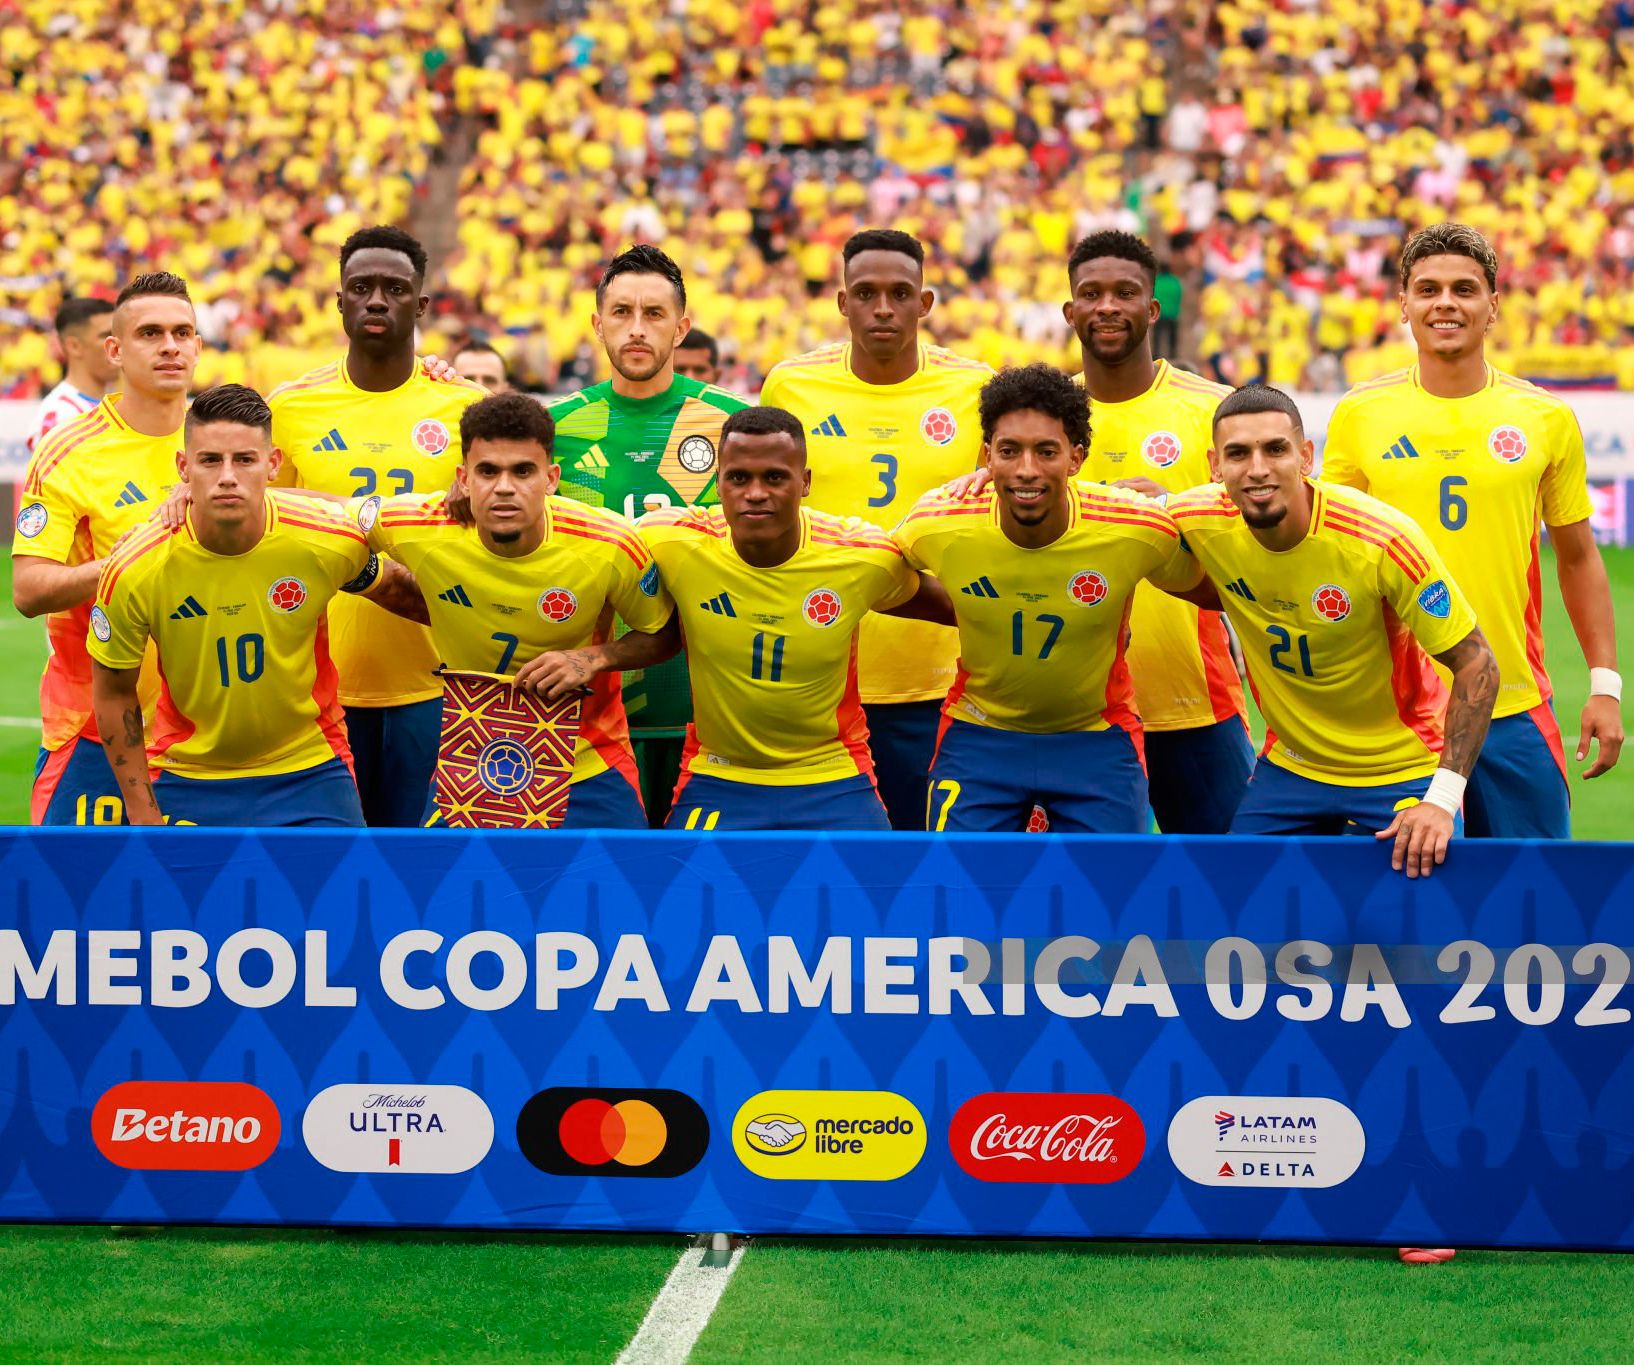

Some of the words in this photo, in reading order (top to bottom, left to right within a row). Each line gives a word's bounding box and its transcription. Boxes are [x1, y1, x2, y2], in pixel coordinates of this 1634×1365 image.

[349, 467, 414, 497] 23
[868, 454, 898, 507] 3
[1440, 476, 1468, 531] 6
[491, 632, 519, 674] 7
[1012, 610, 1064, 660] 17
[1266, 624, 1315, 676] 21
[217, 633, 265, 687] 10
[752, 632, 786, 682] 11
[0, 928, 357, 1008] MEBOL
[380, 929, 671, 1011] COPA
[685, 934, 1180, 1018] AMERICA
[363, 1094, 427, 1108] Michelob
[111, 1108, 261, 1143] Betano
[350, 1112, 444, 1132] ULTRA
[815, 1116, 913, 1134] mercado
[970, 1113, 1123, 1162] Coca-Cola
[1241, 1115, 1317, 1129] LATAM
[1241, 1134, 1317, 1144] AIRLINES
[815, 1135, 863, 1153] libre
[1242, 1162, 1315, 1177] DELTA
